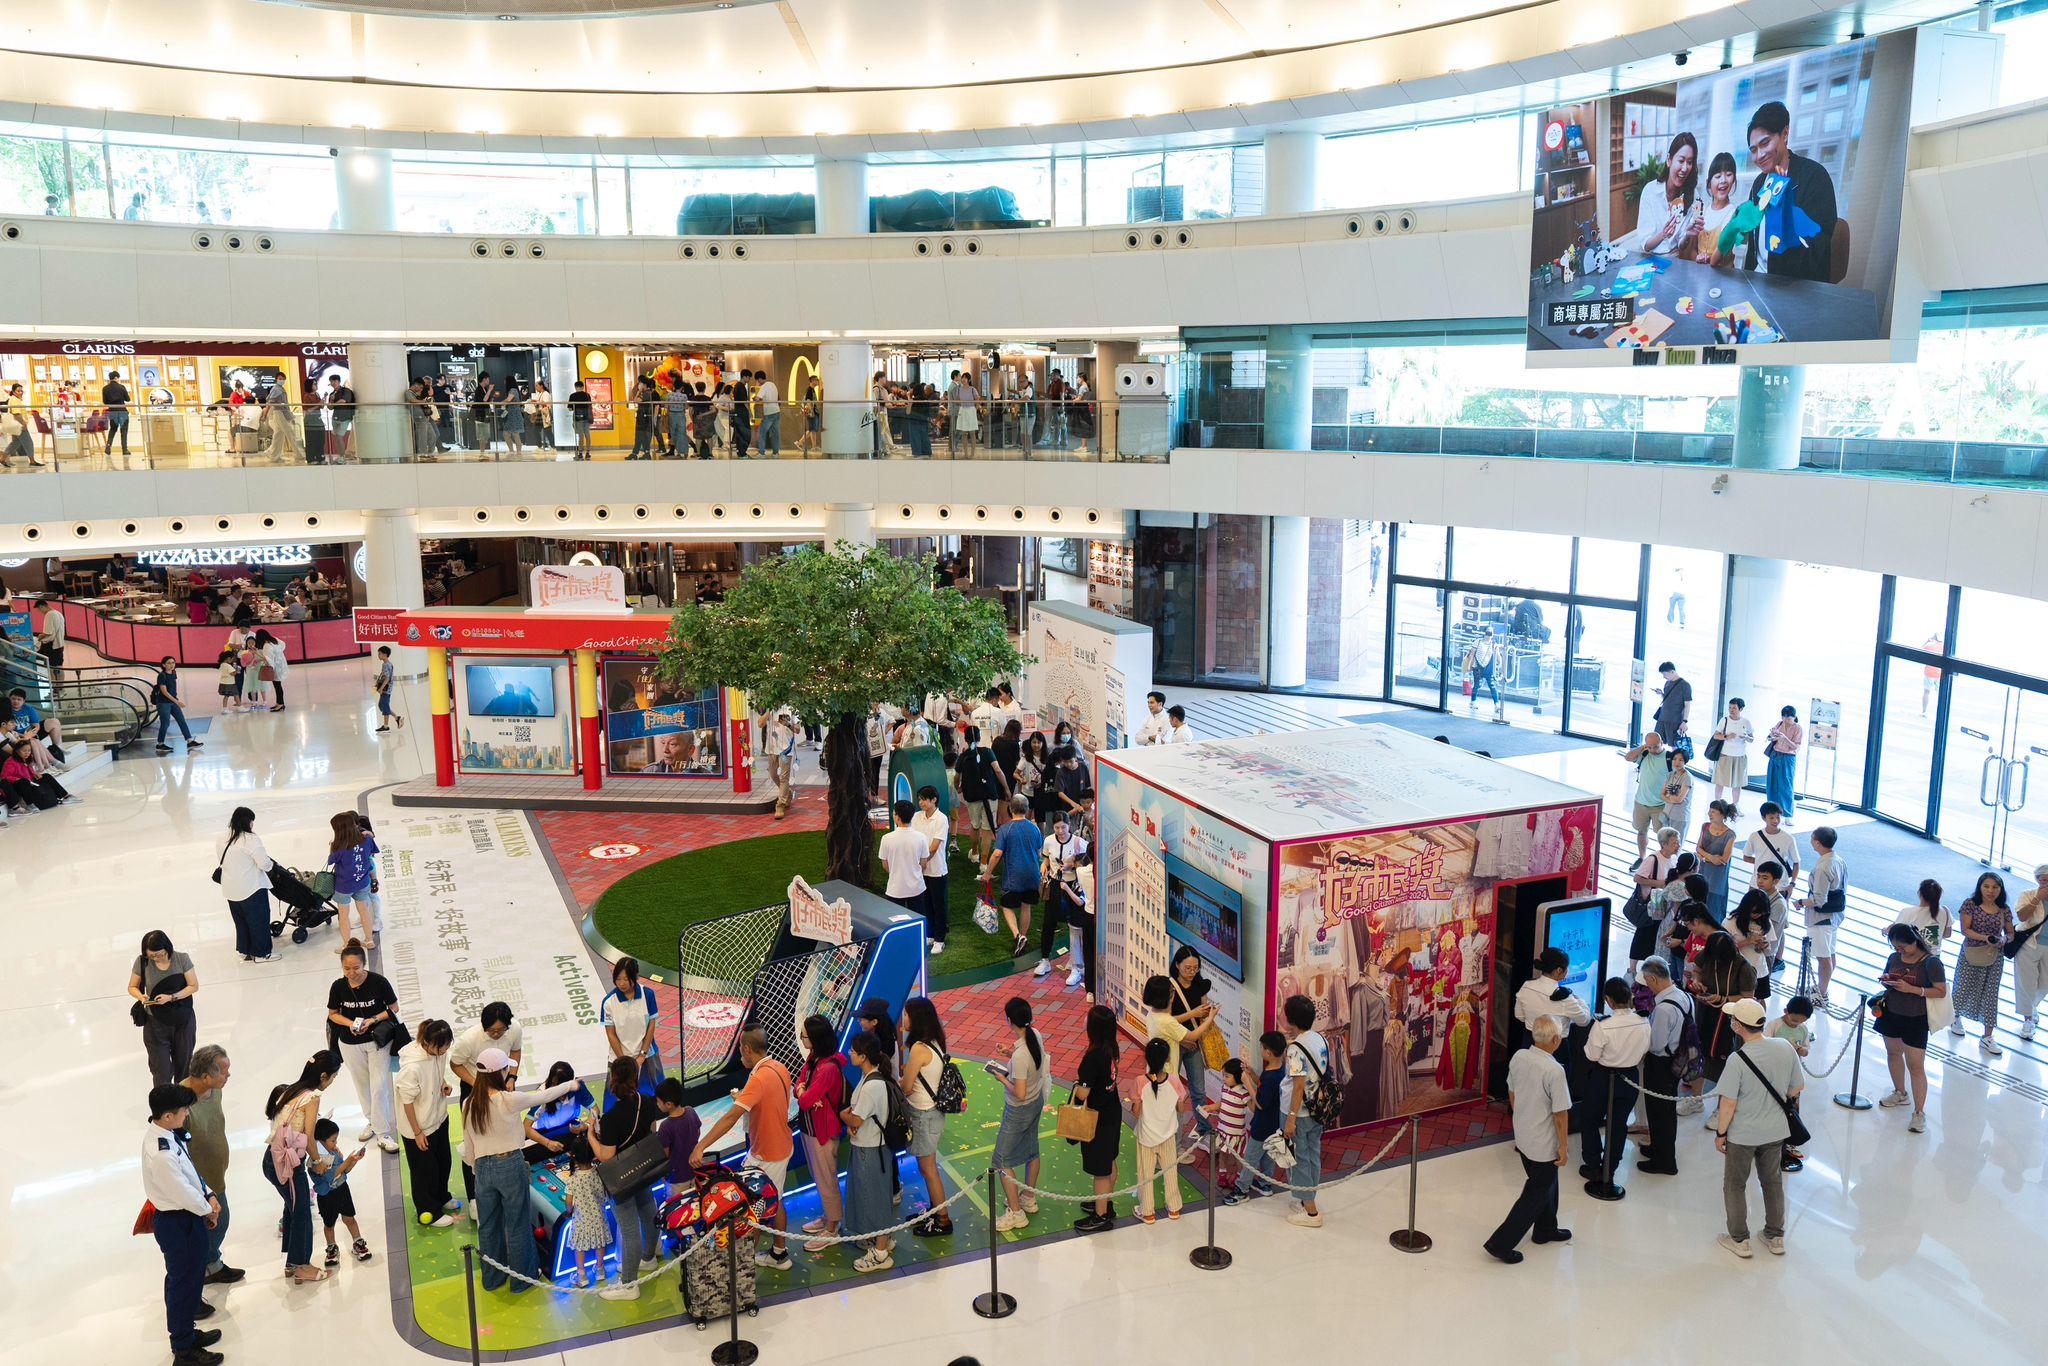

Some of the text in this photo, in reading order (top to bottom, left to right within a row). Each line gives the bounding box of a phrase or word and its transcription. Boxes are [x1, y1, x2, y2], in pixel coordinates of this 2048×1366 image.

[1553, 302, 1628, 323] 商場專屬活動
[62, 344, 135, 354] CLARINS
[302, 346, 349, 355] CLARI
[468, 347, 486, 358] ghd
[1665, 347, 1695, 365] Town
[1702, 346, 1736, 365] Plaza
[494, 816, 533, 858] CALMNESS
[1343, 904, 1373, 920] Good
[1373, 897, 1396, 911] Citizen
[1409, 890, 1428, 900] 2024
[392, 941, 416, 966] GOOD
[396, 967, 424, 1006] CITIZEN
[553, 954, 599, 1026] Activeness
